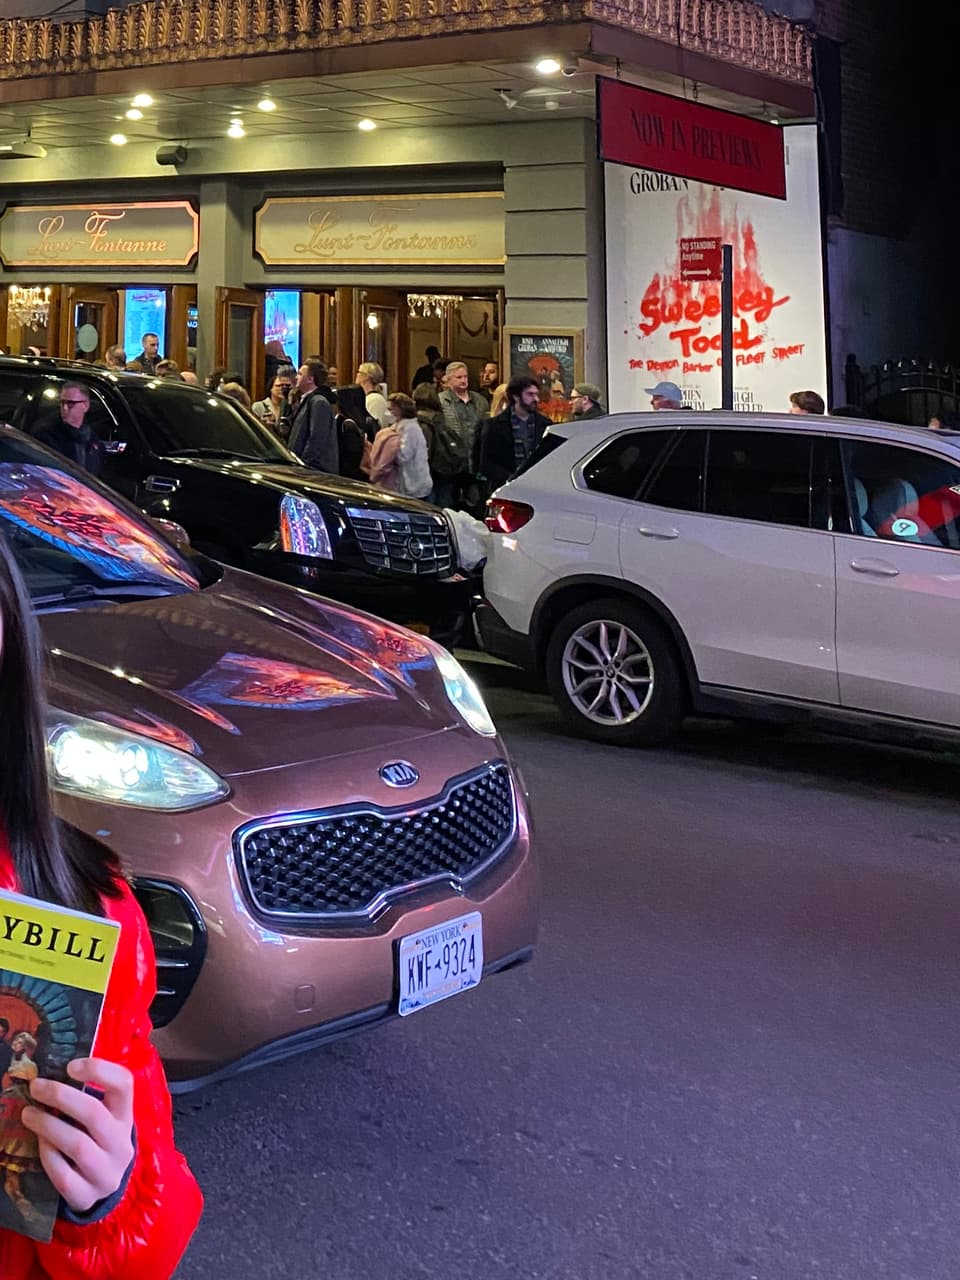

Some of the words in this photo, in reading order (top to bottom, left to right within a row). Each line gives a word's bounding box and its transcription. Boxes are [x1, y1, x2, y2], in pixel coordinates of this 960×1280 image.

[631, 107, 665, 147] NOW
[672, 119, 687, 152] IN
[692, 125, 761, 169] PREVIEWS
[639, 286, 790, 336] Sweeey
[420, 933, 440, 950] NEW
[440, 925, 462, 943] YORK
[442, 933, 476, 980] 9324
